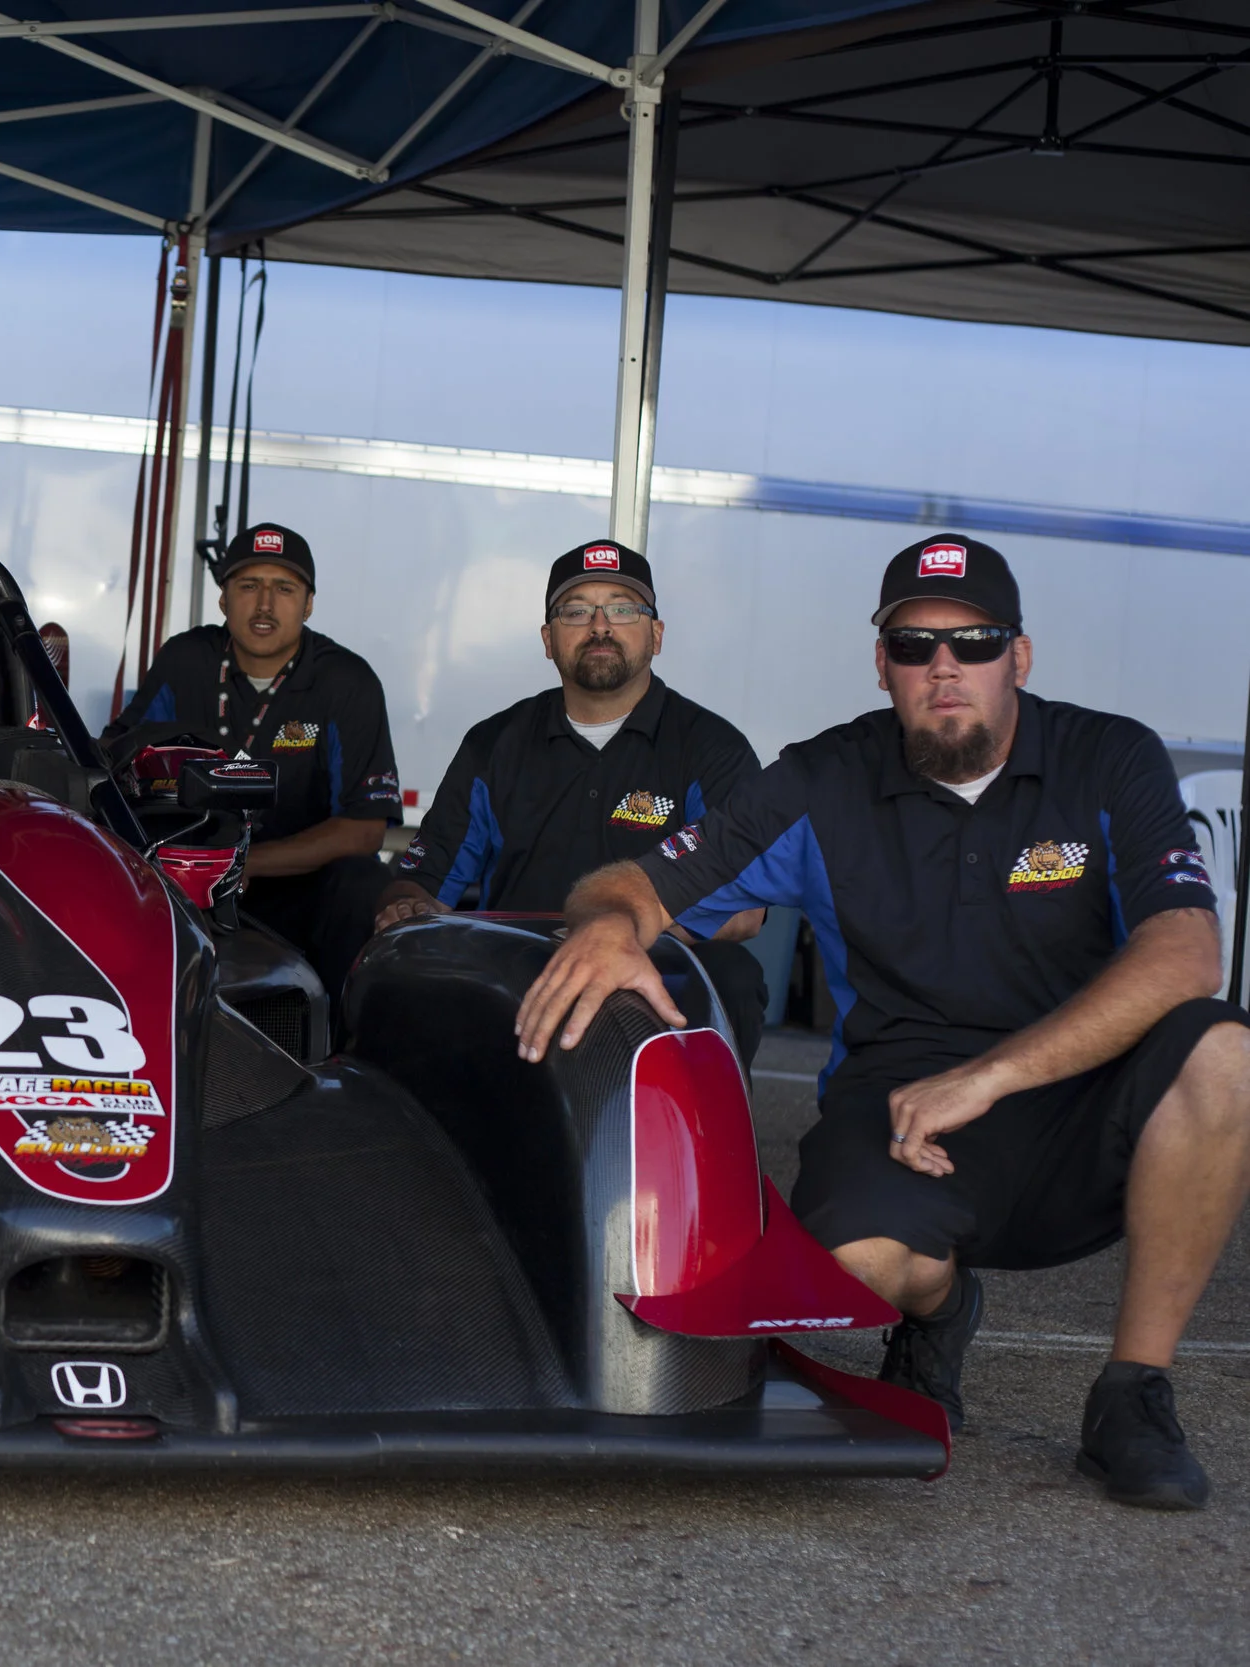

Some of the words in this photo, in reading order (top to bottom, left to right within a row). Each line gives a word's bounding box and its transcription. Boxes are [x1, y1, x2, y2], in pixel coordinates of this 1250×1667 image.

[585, 550, 617, 561] TOR
[922, 550, 963, 566] TOR
[611, 809, 668, 826] BULLDOG
[1008, 865, 1085, 884] BULLDOG
[100, 1096, 156, 1106] CLUB
[748, 1318, 855, 1328] AVON
